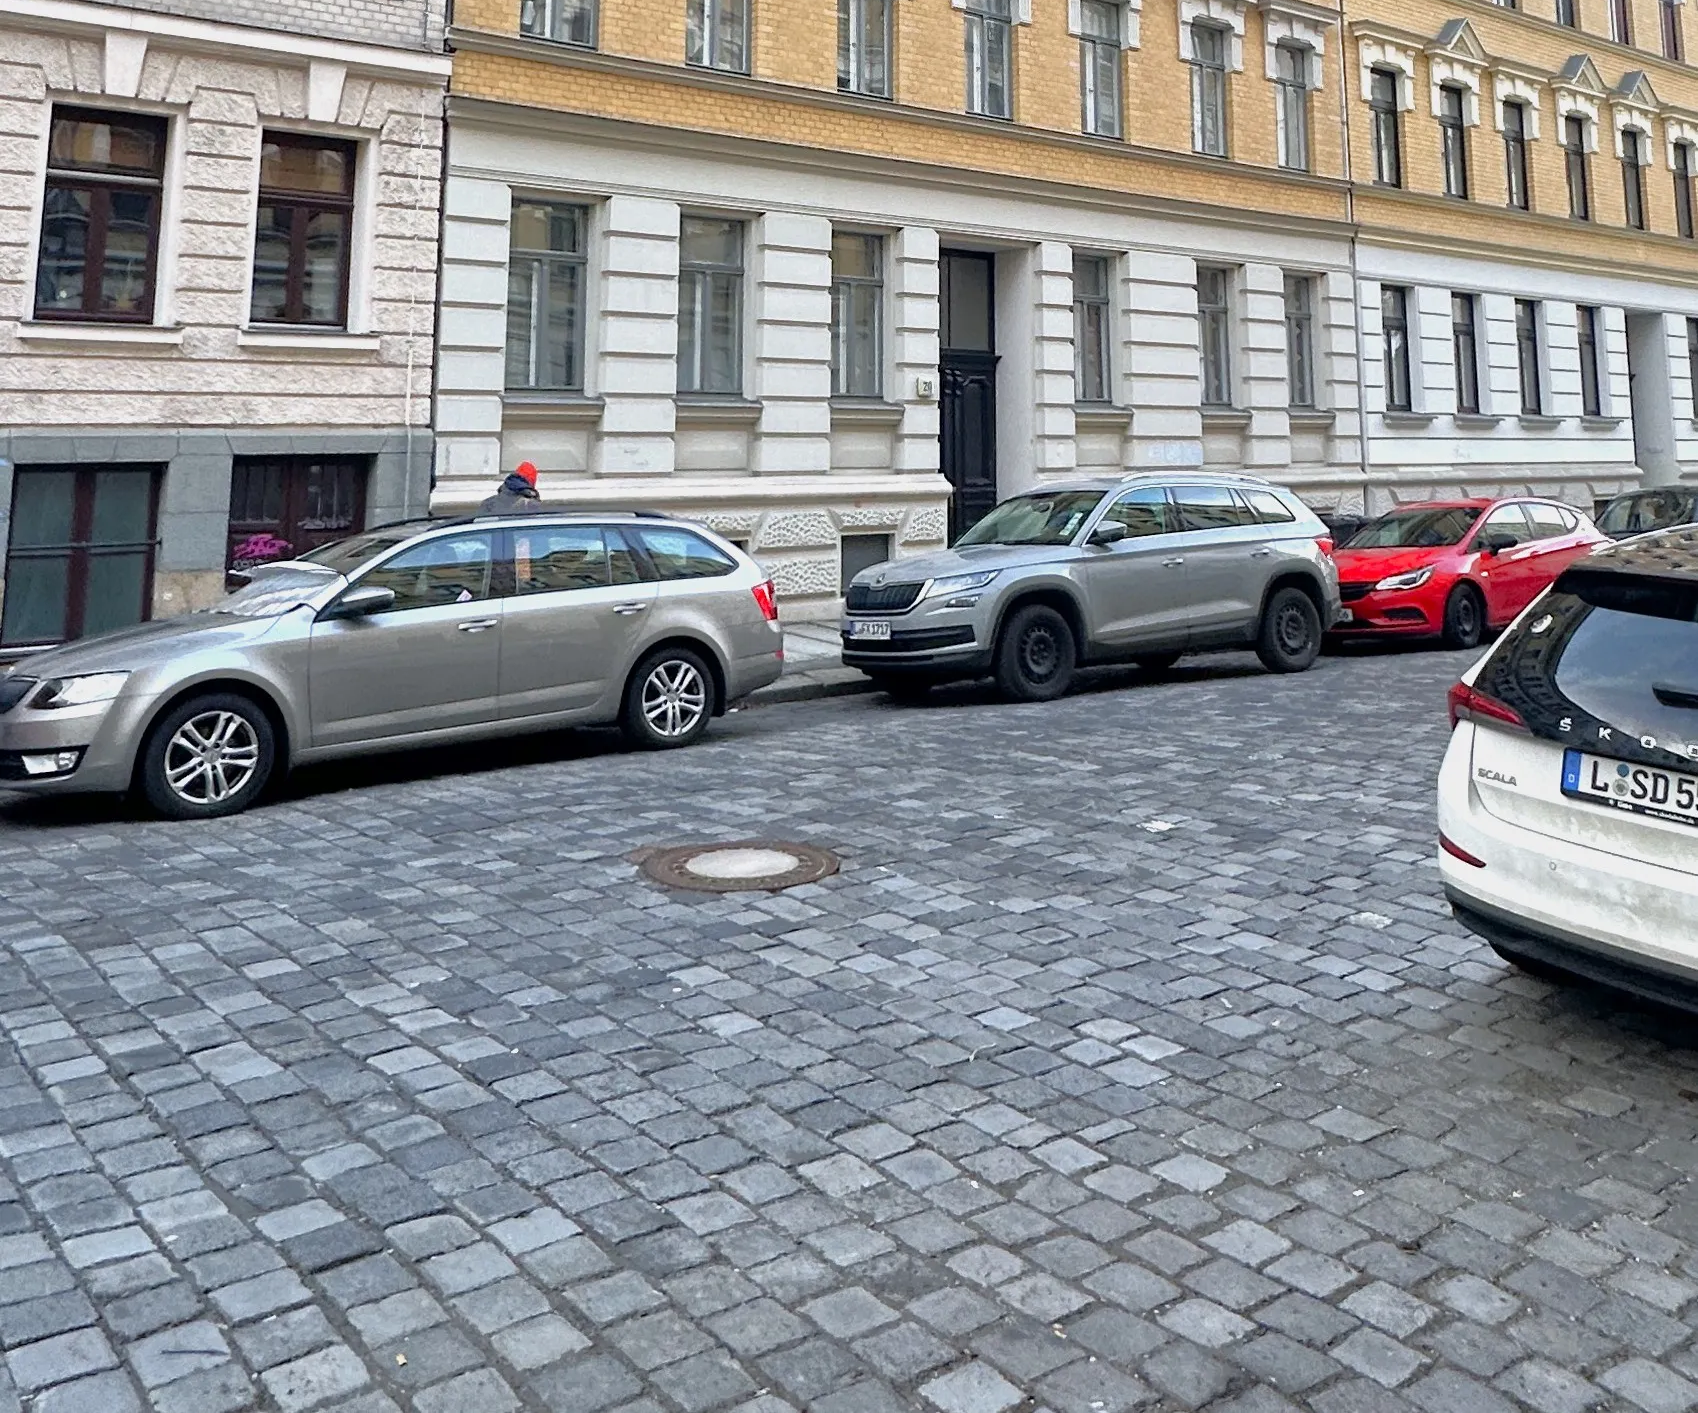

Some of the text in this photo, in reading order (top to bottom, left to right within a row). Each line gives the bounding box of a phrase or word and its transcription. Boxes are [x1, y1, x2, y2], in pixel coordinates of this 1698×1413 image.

[1477, 767, 1517, 787] SCALA
[1591, 760, 1698, 810] L SD 5
